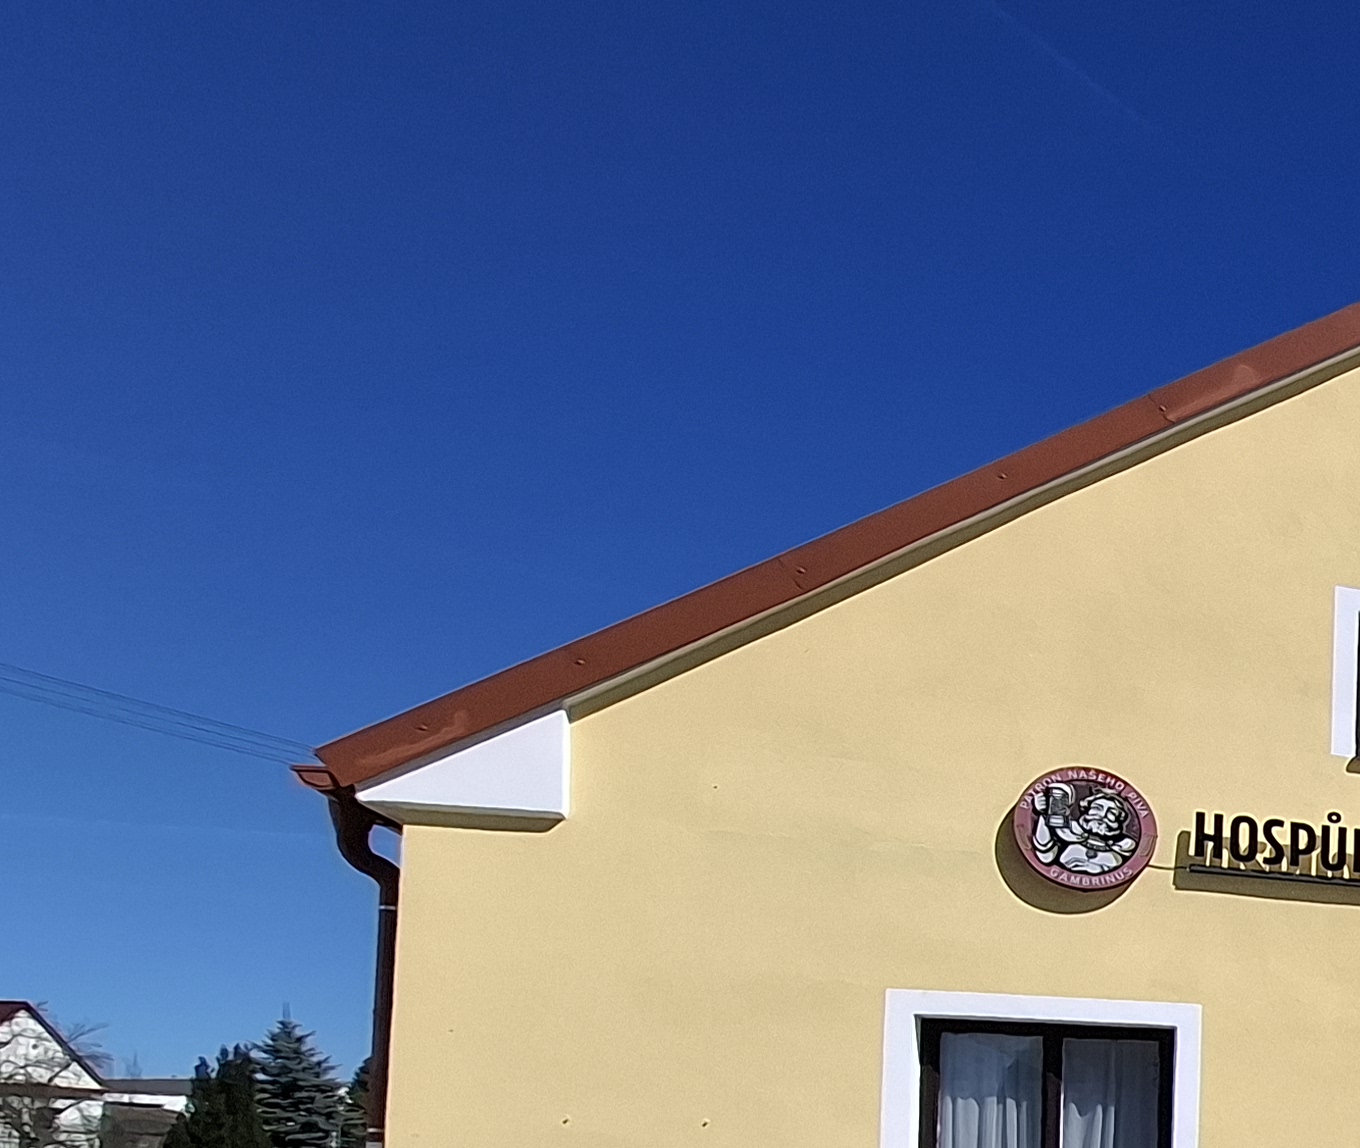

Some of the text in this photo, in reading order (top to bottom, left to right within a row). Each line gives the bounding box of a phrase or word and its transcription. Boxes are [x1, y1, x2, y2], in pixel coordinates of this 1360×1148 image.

[1019, 768, 1150, 818] PATRON NAŠEHO PIVA
[1049, 866, 1134, 887] GAMBRINUS
